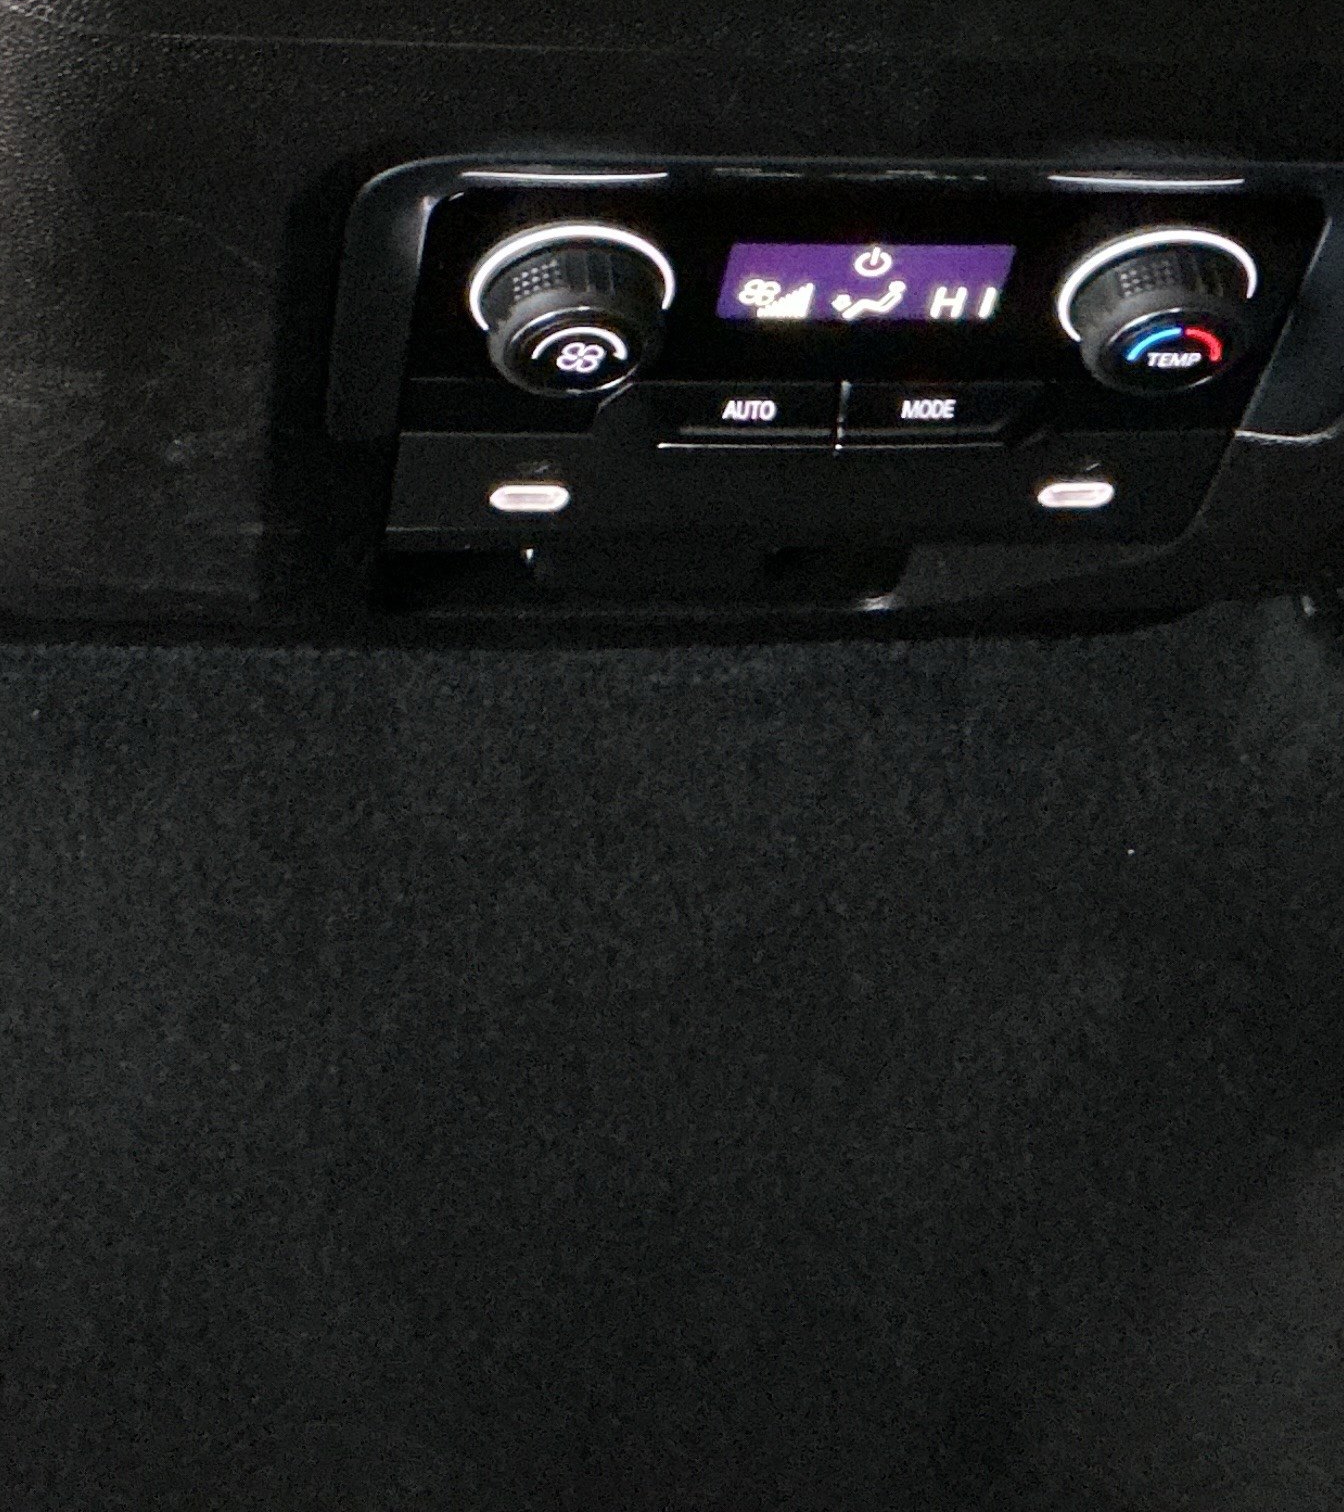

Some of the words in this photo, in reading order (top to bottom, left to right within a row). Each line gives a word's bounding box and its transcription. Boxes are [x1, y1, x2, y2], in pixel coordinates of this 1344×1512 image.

[929, 286, 998, 319] HI
[1147, 352, 1202, 368] TEMP
[721, 399, 777, 421] AUTO
[900, 399, 956, 420] MODE
